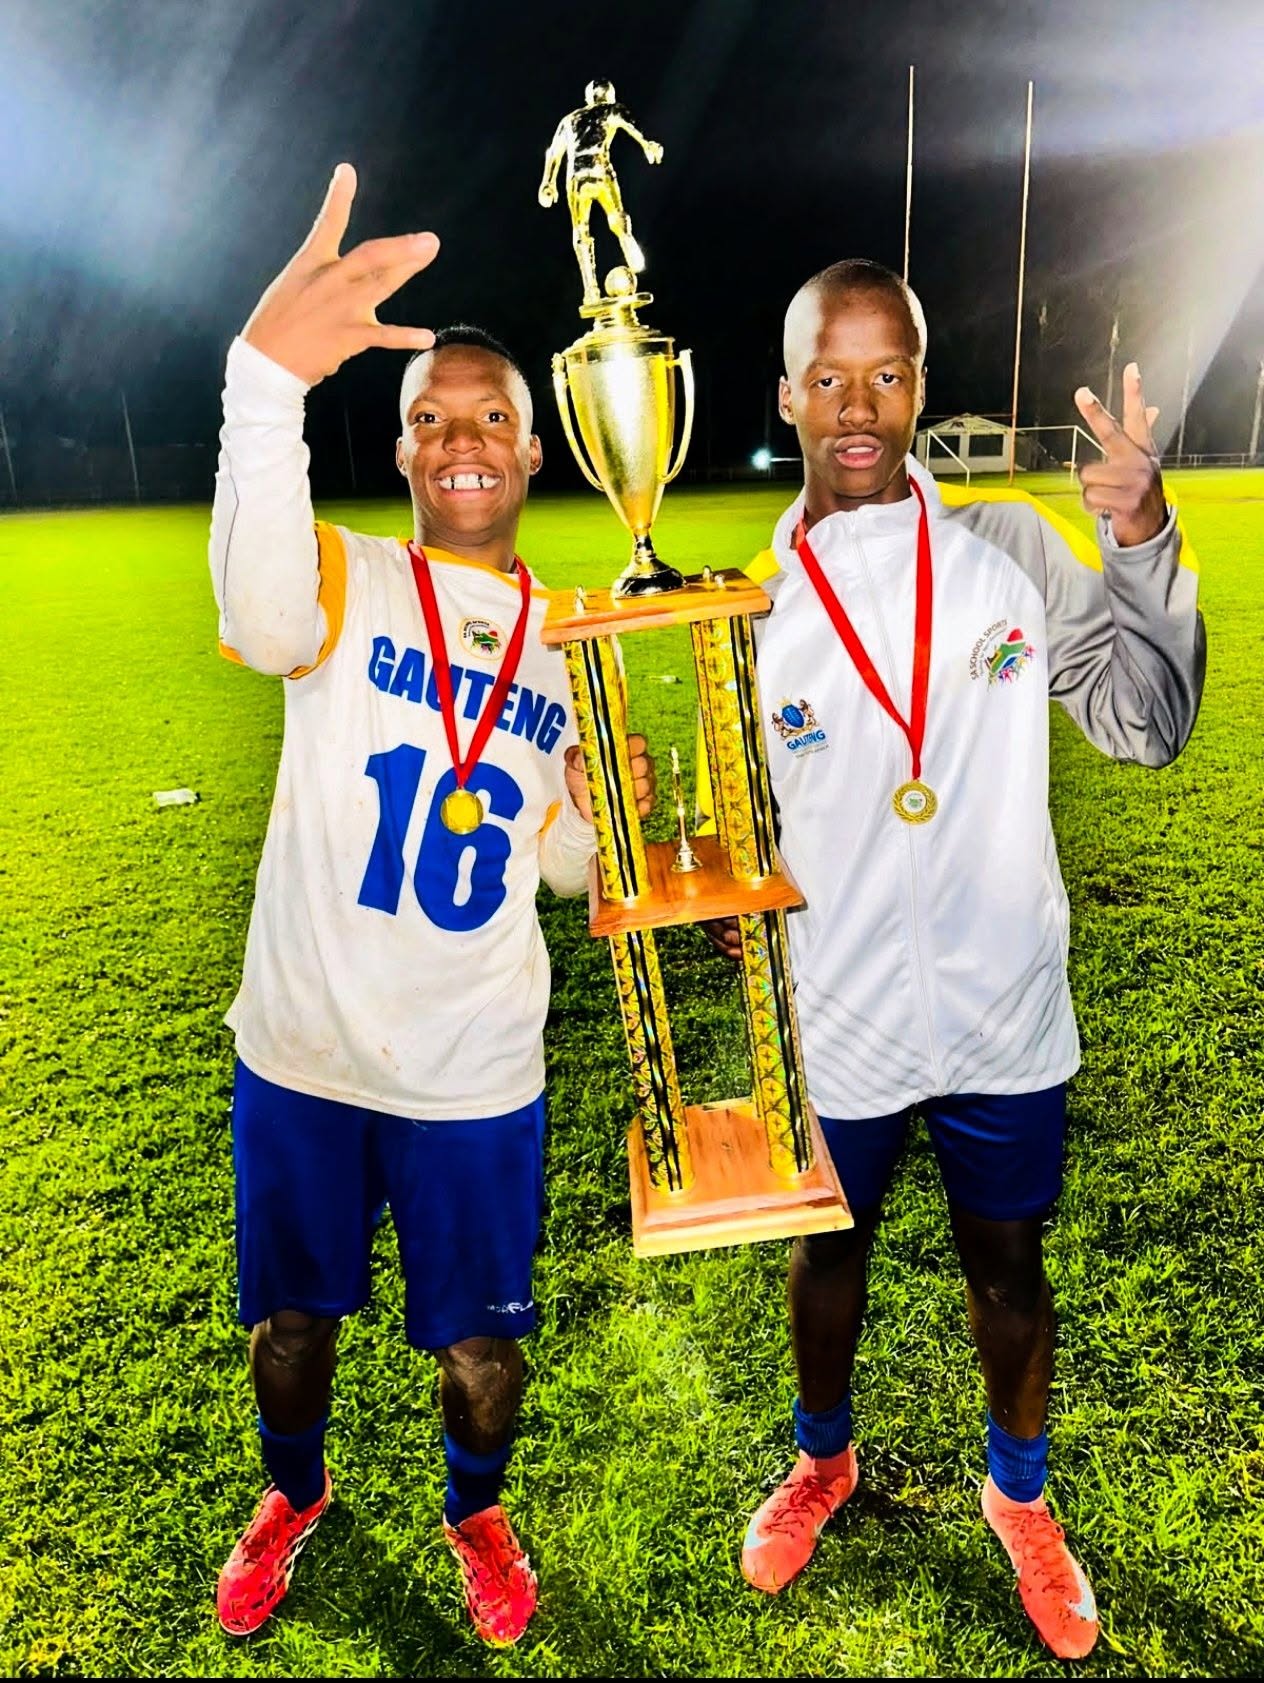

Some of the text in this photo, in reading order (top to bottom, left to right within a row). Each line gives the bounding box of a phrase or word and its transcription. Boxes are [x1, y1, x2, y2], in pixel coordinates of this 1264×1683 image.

[368, 636, 567, 755] GAUTENG
[970, 638, 986, 669] SCHOOL
[357, 743, 524, 932] 16
